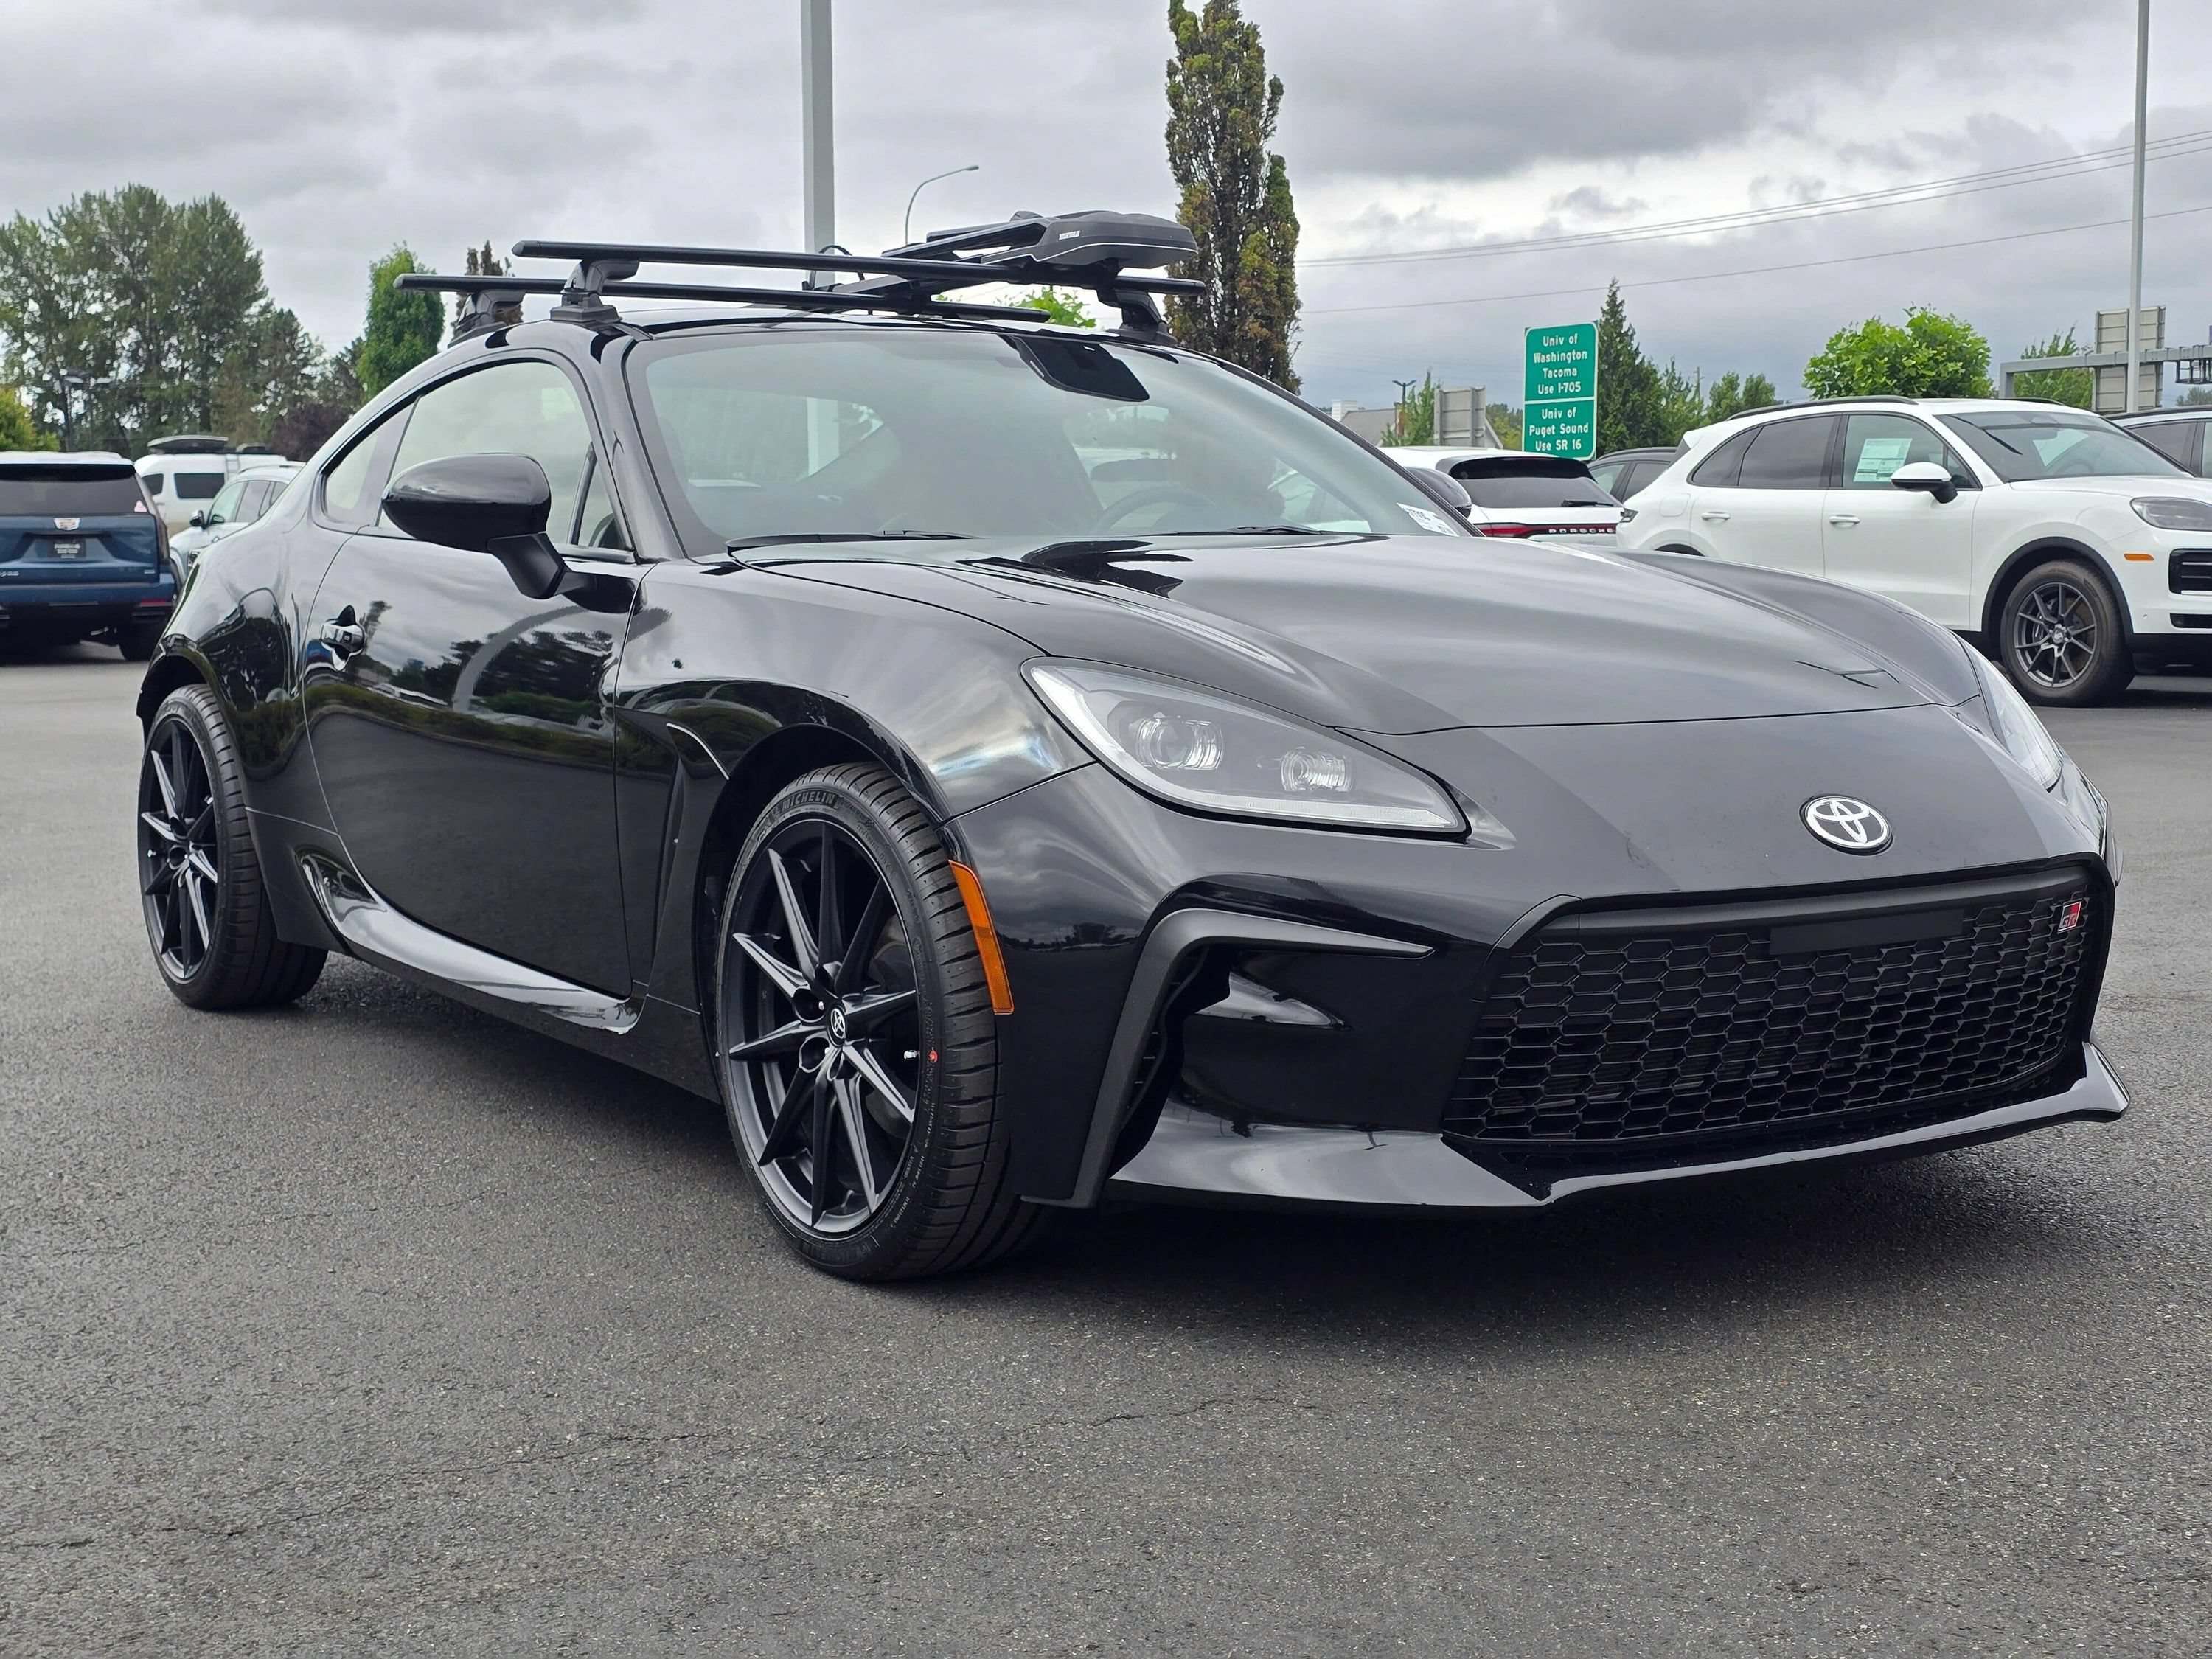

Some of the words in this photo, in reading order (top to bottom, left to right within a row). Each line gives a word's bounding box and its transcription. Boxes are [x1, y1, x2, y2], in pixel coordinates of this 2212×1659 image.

[1543, 335, 1565, 347] Univ
[1568, 333, 1578, 344] of
[1533, 349, 1587, 364] Washington
[1543, 367, 1577, 378] Tacoma
[1537, 383, 1554, 394] Use
[1558, 381, 1582, 393] I-705
[1541, 408, 1563, 420] Univ
[1567, 407, 1576, 418] of
[1529, 425, 1556, 438] Puget
[1559, 422, 1589, 434] Sound
[1535, 440, 1551, 451] Use
[1556, 439, 1568, 451] SR
[1572, 439, 1582, 450] 16
[782, 790, 836, 811] MICHELIN
[2059, 913, 2077, 928] GR
